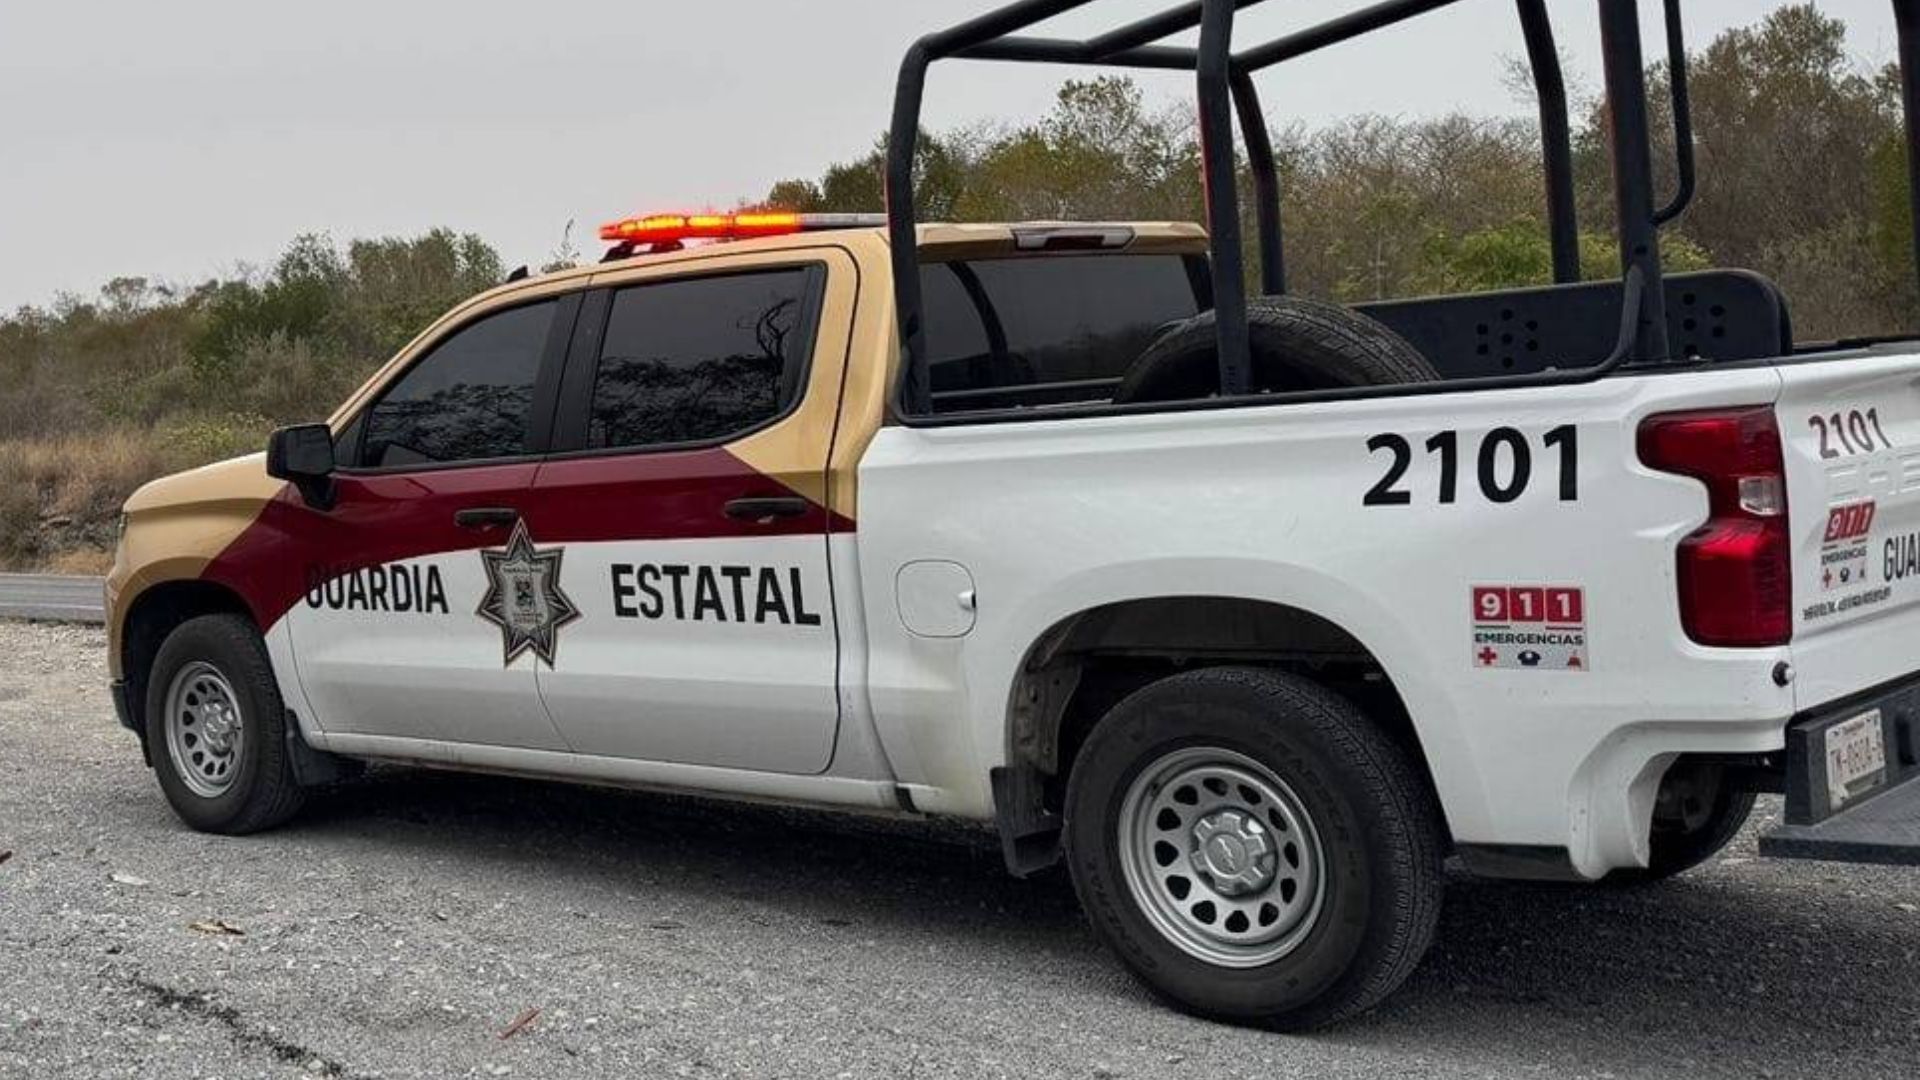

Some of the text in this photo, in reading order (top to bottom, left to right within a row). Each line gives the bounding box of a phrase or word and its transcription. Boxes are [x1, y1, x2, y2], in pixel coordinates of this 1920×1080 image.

[1808, 407, 1892, 459] 2101
[1362, 424, 1578, 506] 2101
[1827, 504, 1874, 539] 911
[1883, 532, 1920, 582] GUA
[610, 563, 821, 626] ESTATAL
[1481, 592, 1571, 617] 911
[1474, 632, 1584, 645] EMERGENCIAS
